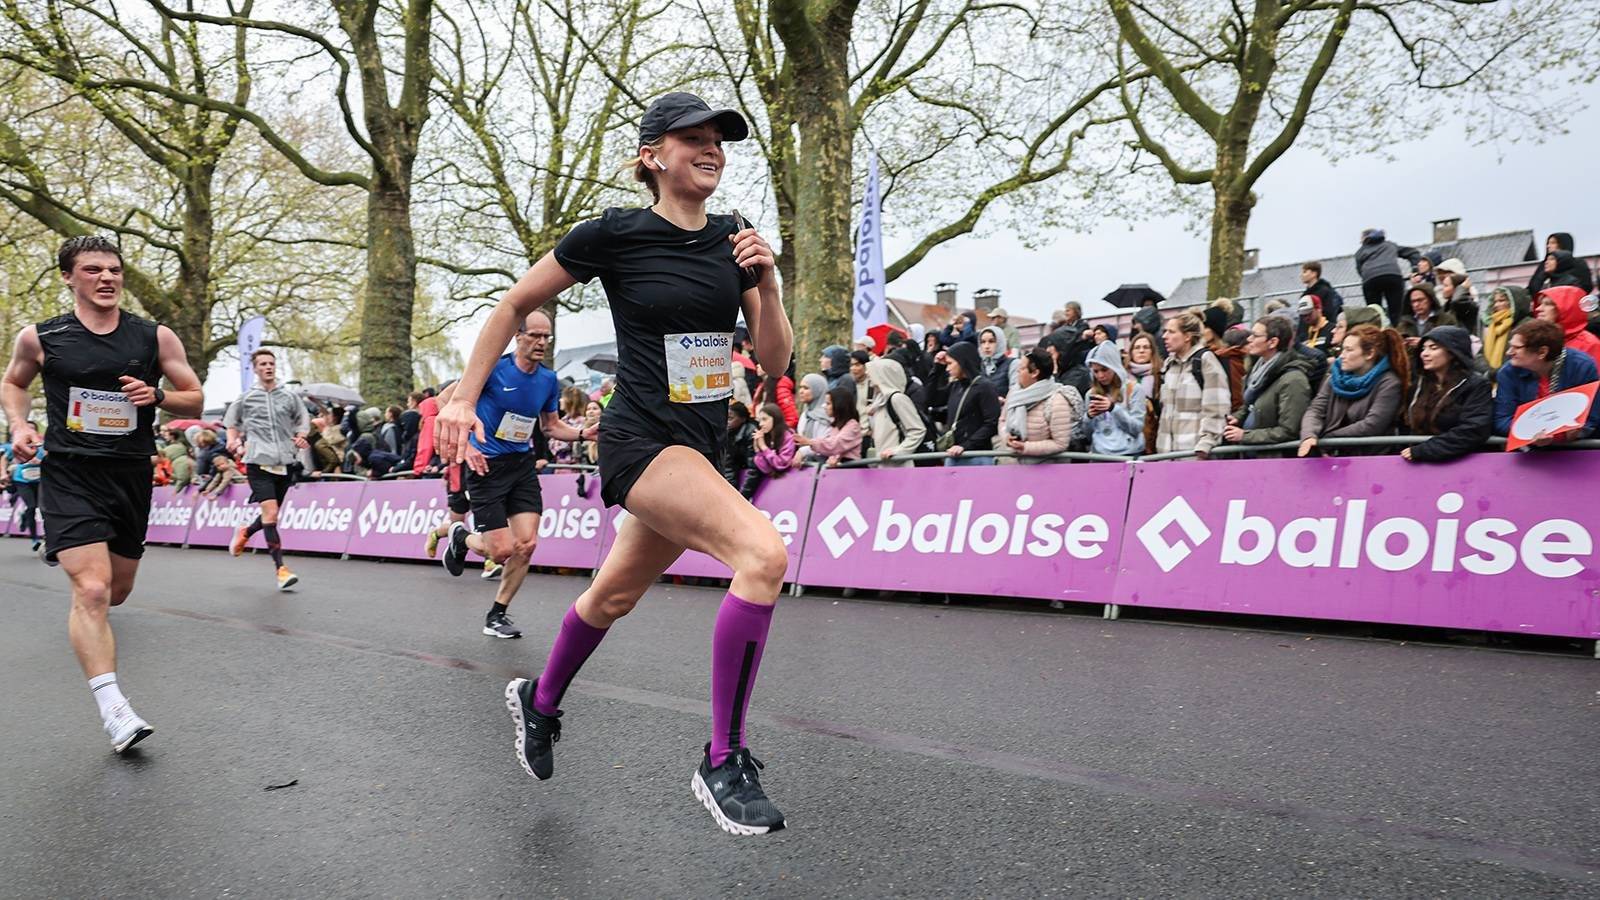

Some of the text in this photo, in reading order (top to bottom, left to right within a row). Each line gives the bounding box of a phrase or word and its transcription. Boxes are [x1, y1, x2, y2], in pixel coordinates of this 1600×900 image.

[694, 334, 729, 347] baloise
[87, 404, 121, 415] Senne
[280, 498, 353, 532] baloise
[376, 497, 450, 535] balois
[538, 495, 600, 539] oise
[872, 494, 1110, 560] baloise
[1219, 492, 1593, 578] baloise
